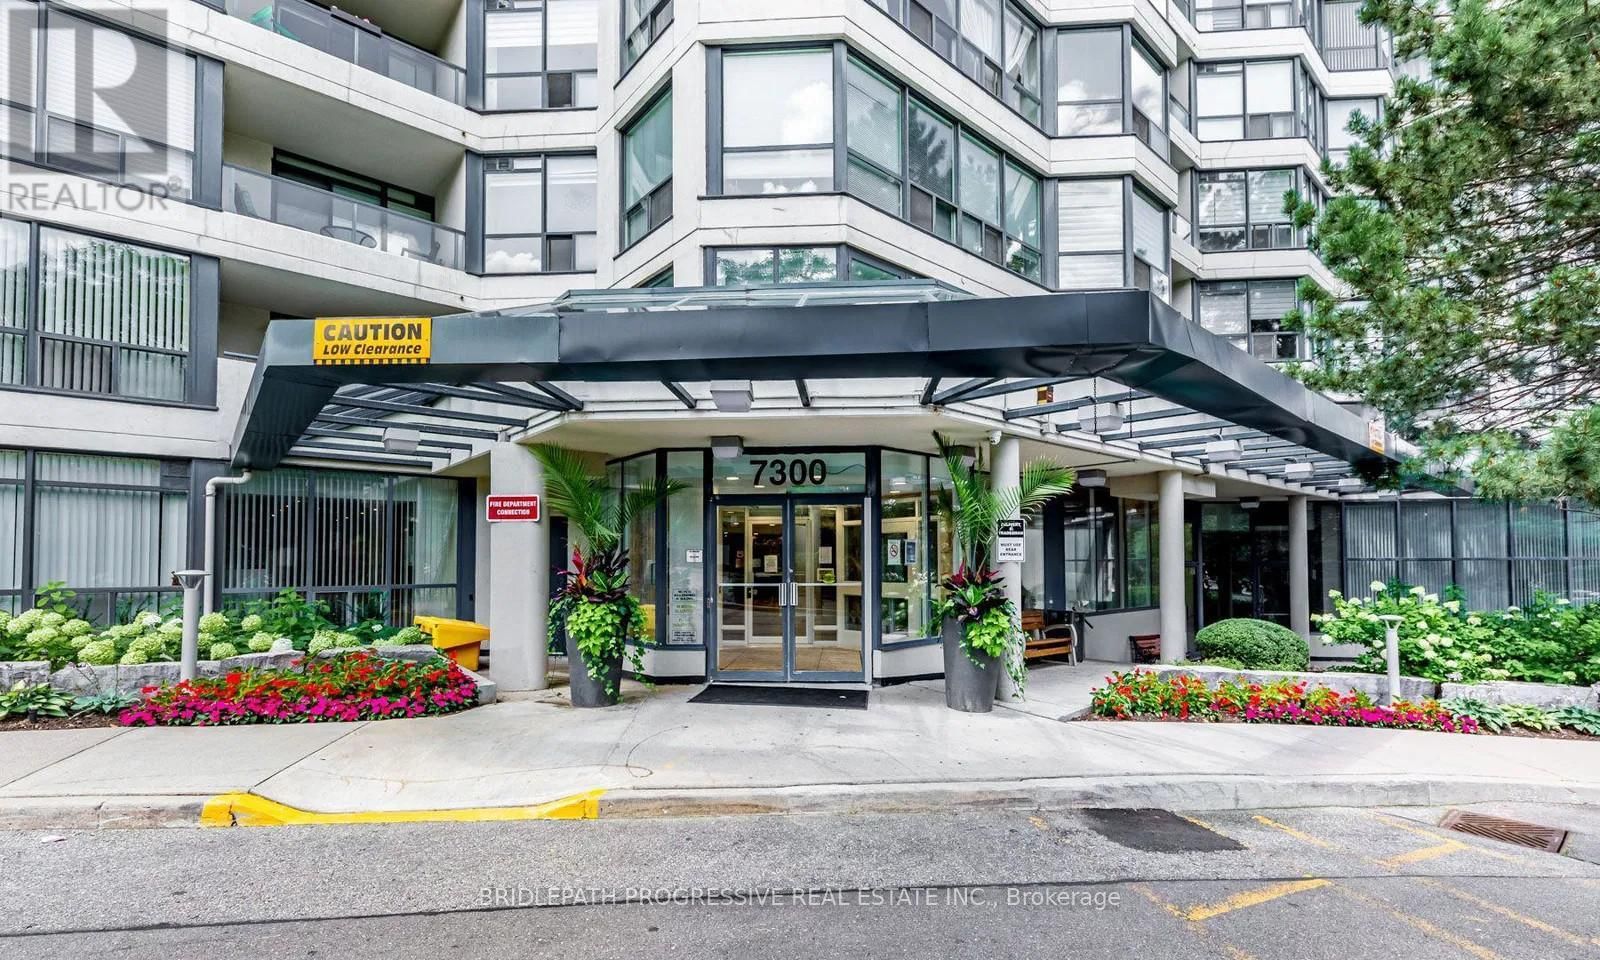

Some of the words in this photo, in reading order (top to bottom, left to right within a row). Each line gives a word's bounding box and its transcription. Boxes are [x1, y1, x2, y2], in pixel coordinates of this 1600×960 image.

[323, 323, 422, 341] CAUTION
[323, 344, 351, 355] LOW
[354, 343, 422, 355] Clearance
[750, 459, 827, 485] 7300
